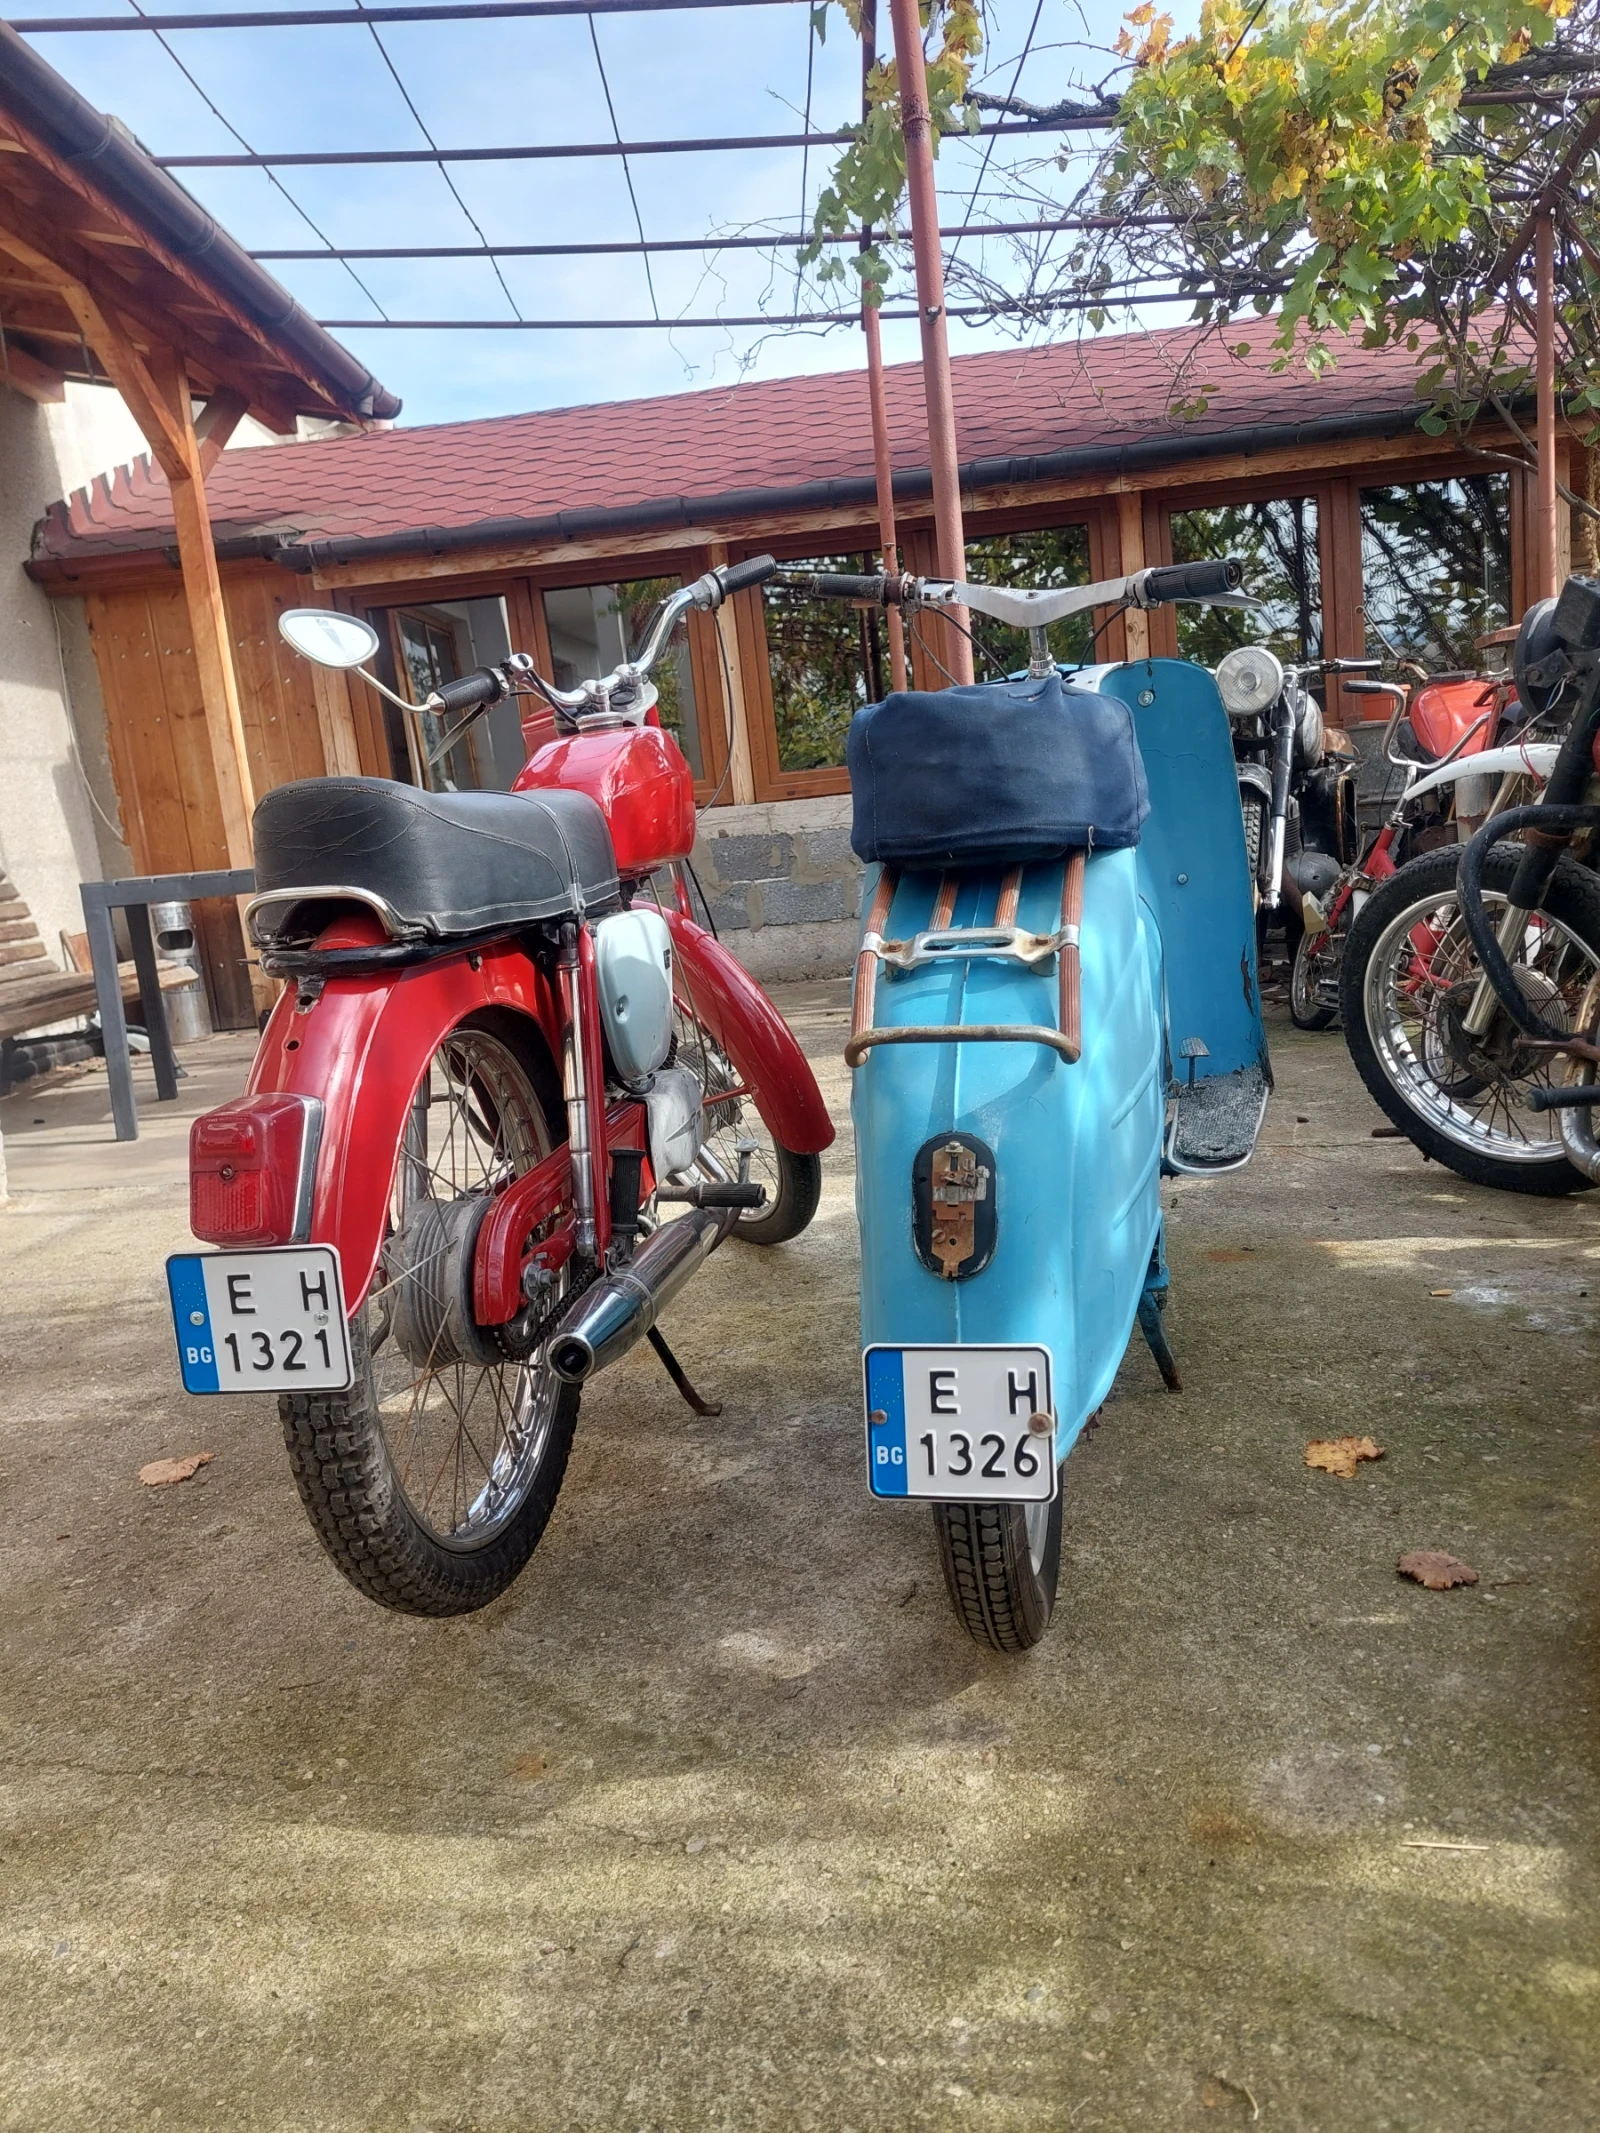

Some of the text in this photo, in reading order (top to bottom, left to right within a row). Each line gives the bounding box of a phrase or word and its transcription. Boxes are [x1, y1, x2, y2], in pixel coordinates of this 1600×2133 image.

[227, 1270, 329, 1314] E H
[186, 1346, 213, 1364] BG
[224, 1329, 331, 1372] 1321
[929, 1370, 1038, 1415] E H
[876, 1445, 904, 1465] BG
[919, 1433, 1040, 1478] 1326
